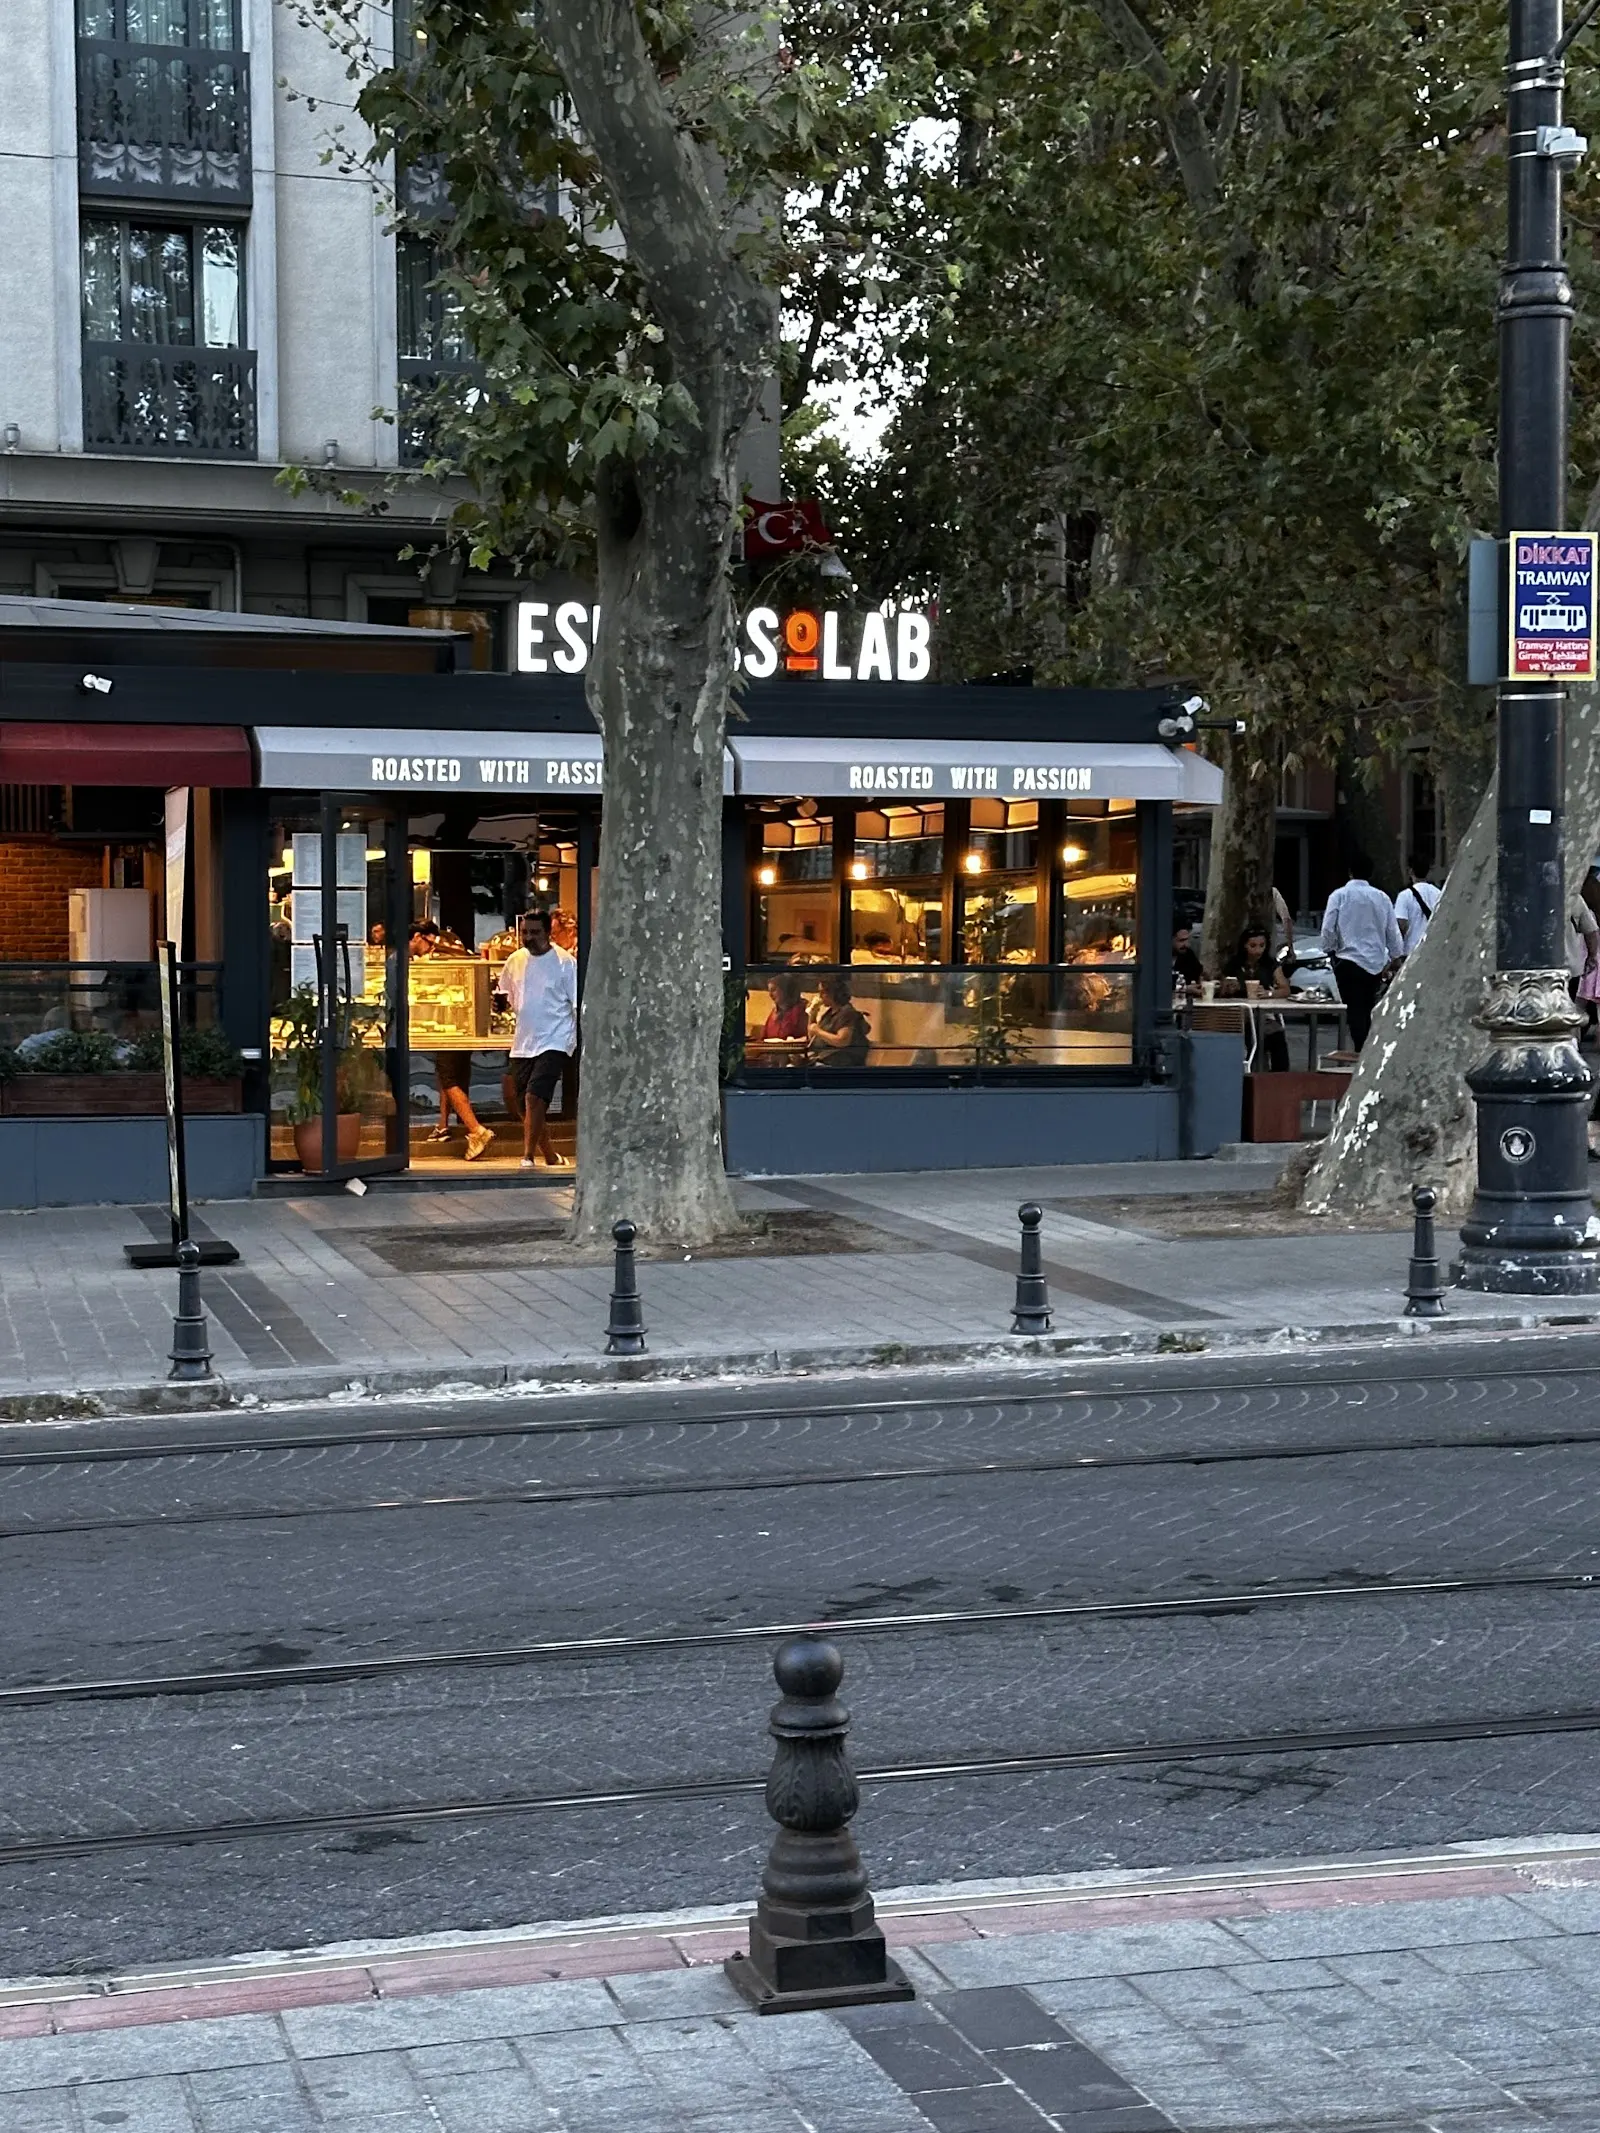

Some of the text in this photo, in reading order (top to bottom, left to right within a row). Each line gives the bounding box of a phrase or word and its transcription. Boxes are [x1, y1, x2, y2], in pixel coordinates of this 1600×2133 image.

[1518, 543, 1591, 565] DİKKAT
[1517, 570, 1591, 586] TRAMVAY
[1517, 641, 1555, 652] Tramvay
[1518, 651, 1589, 661] Girmek Tehlikeli
[1528, 663, 1541, 671] ve
[371, 757, 602, 784] ROASTED WITH PASSI
[849, 766, 1092, 790] ROASTED WITH PASSION
